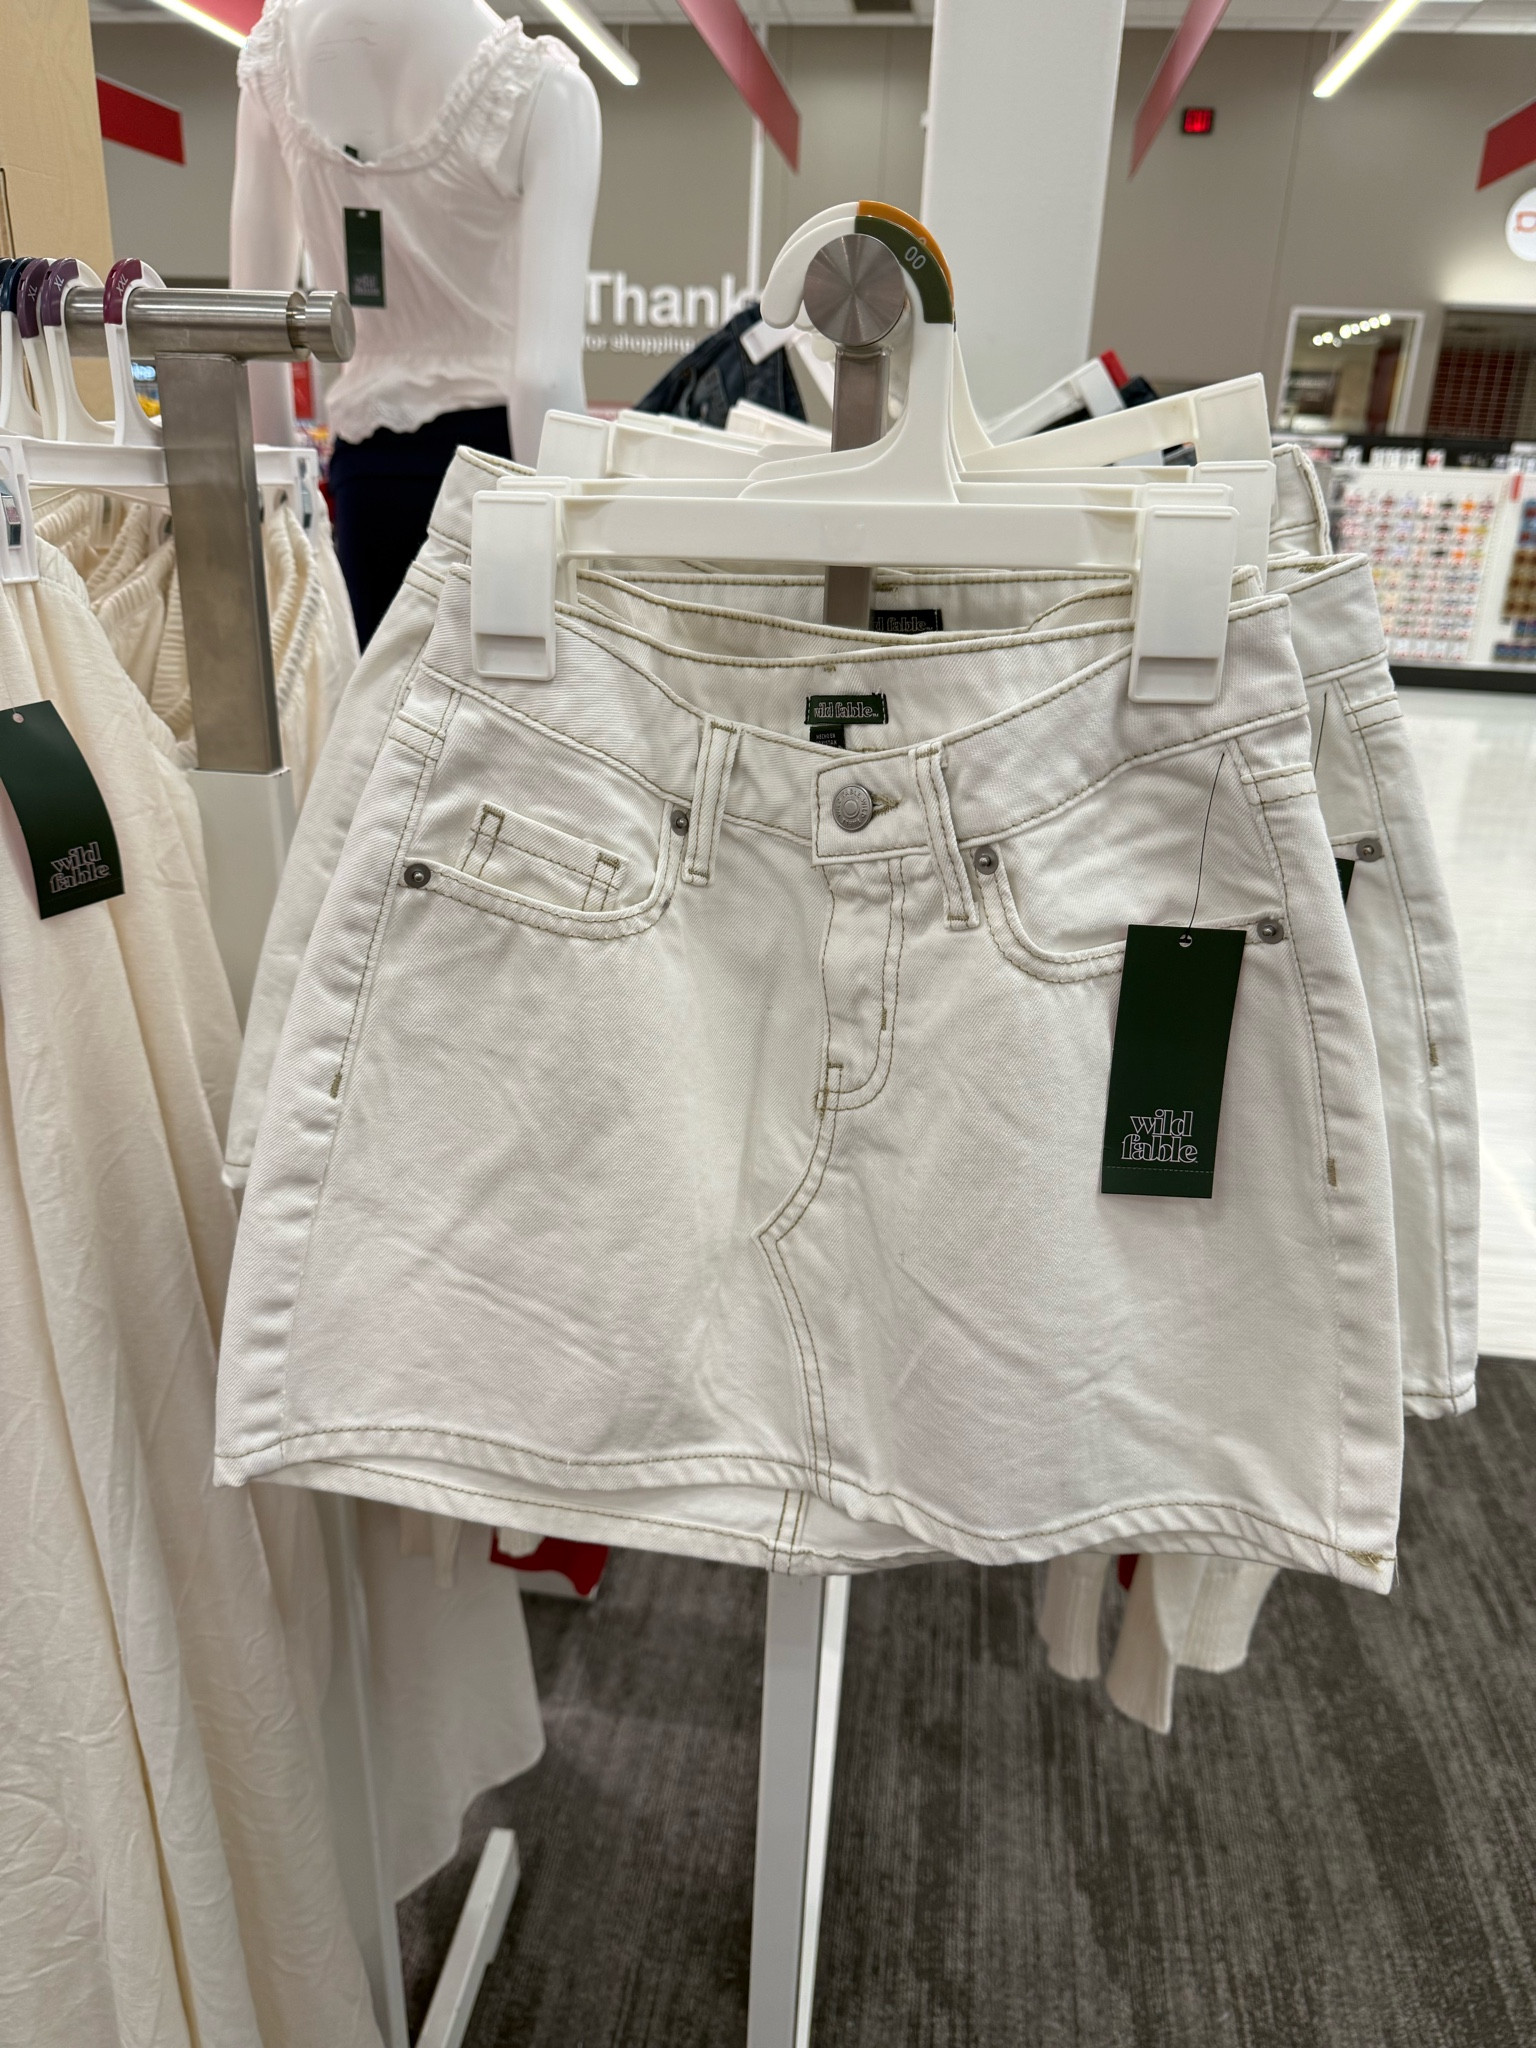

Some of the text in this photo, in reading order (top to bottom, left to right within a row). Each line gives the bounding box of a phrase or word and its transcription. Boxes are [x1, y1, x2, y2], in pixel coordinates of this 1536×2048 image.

[904, 246, 927, 270] 00
[28, 285, 38, 300] XL
[54, 275, 65, 291] XL
[116, 273, 129, 296] XXL
[814, 702, 874, 718] wild fable
[51, 841, 102, 874] wild
[50, 863, 111, 893] fable
[1130, 1108, 1194, 1137] wild
[1121, 1133, 1198, 1163] fable
